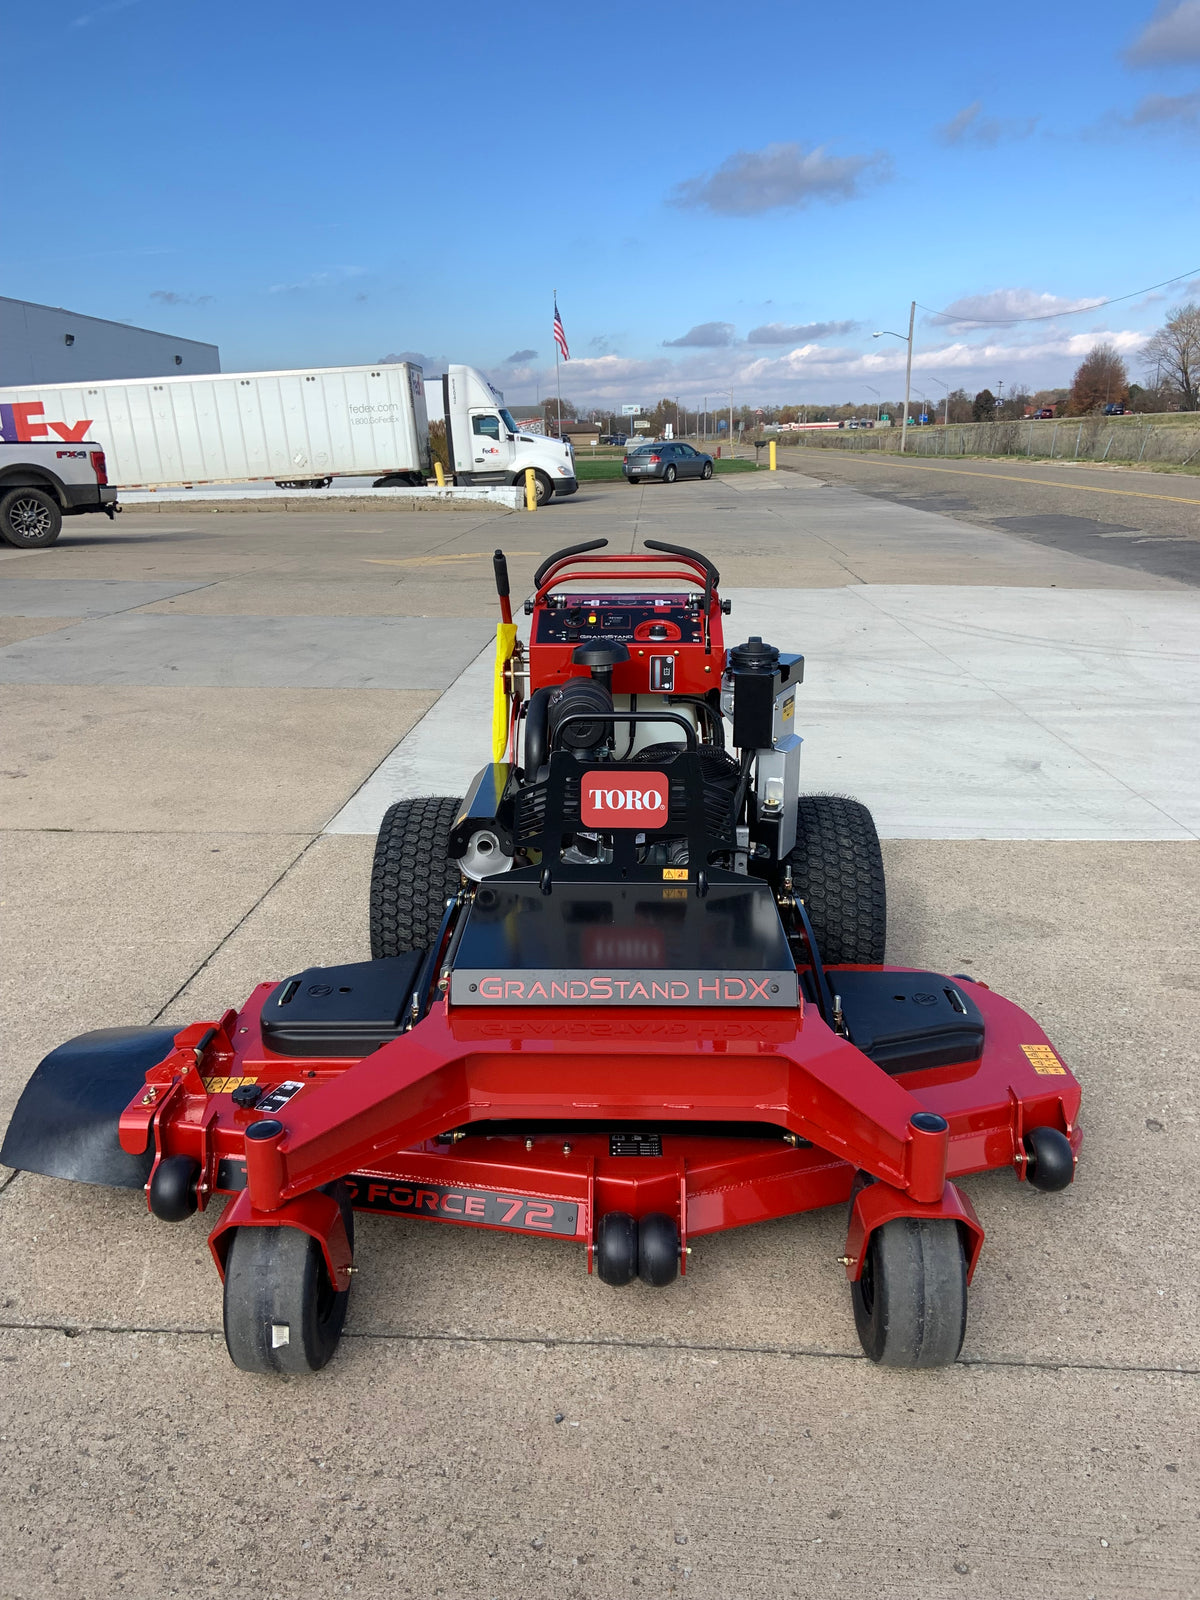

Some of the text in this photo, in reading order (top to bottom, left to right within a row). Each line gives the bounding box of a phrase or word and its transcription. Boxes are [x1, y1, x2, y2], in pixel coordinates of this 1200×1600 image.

[348, 403, 399, 414] fedex.com
[56, 451, 87, 459] FX4
[482, 447, 499, 455] FedEx
[698, 978, 771, 1001] HDX
[367, 1183, 487, 1217] FORCE
[496, 1197, 555, 1229] 72
